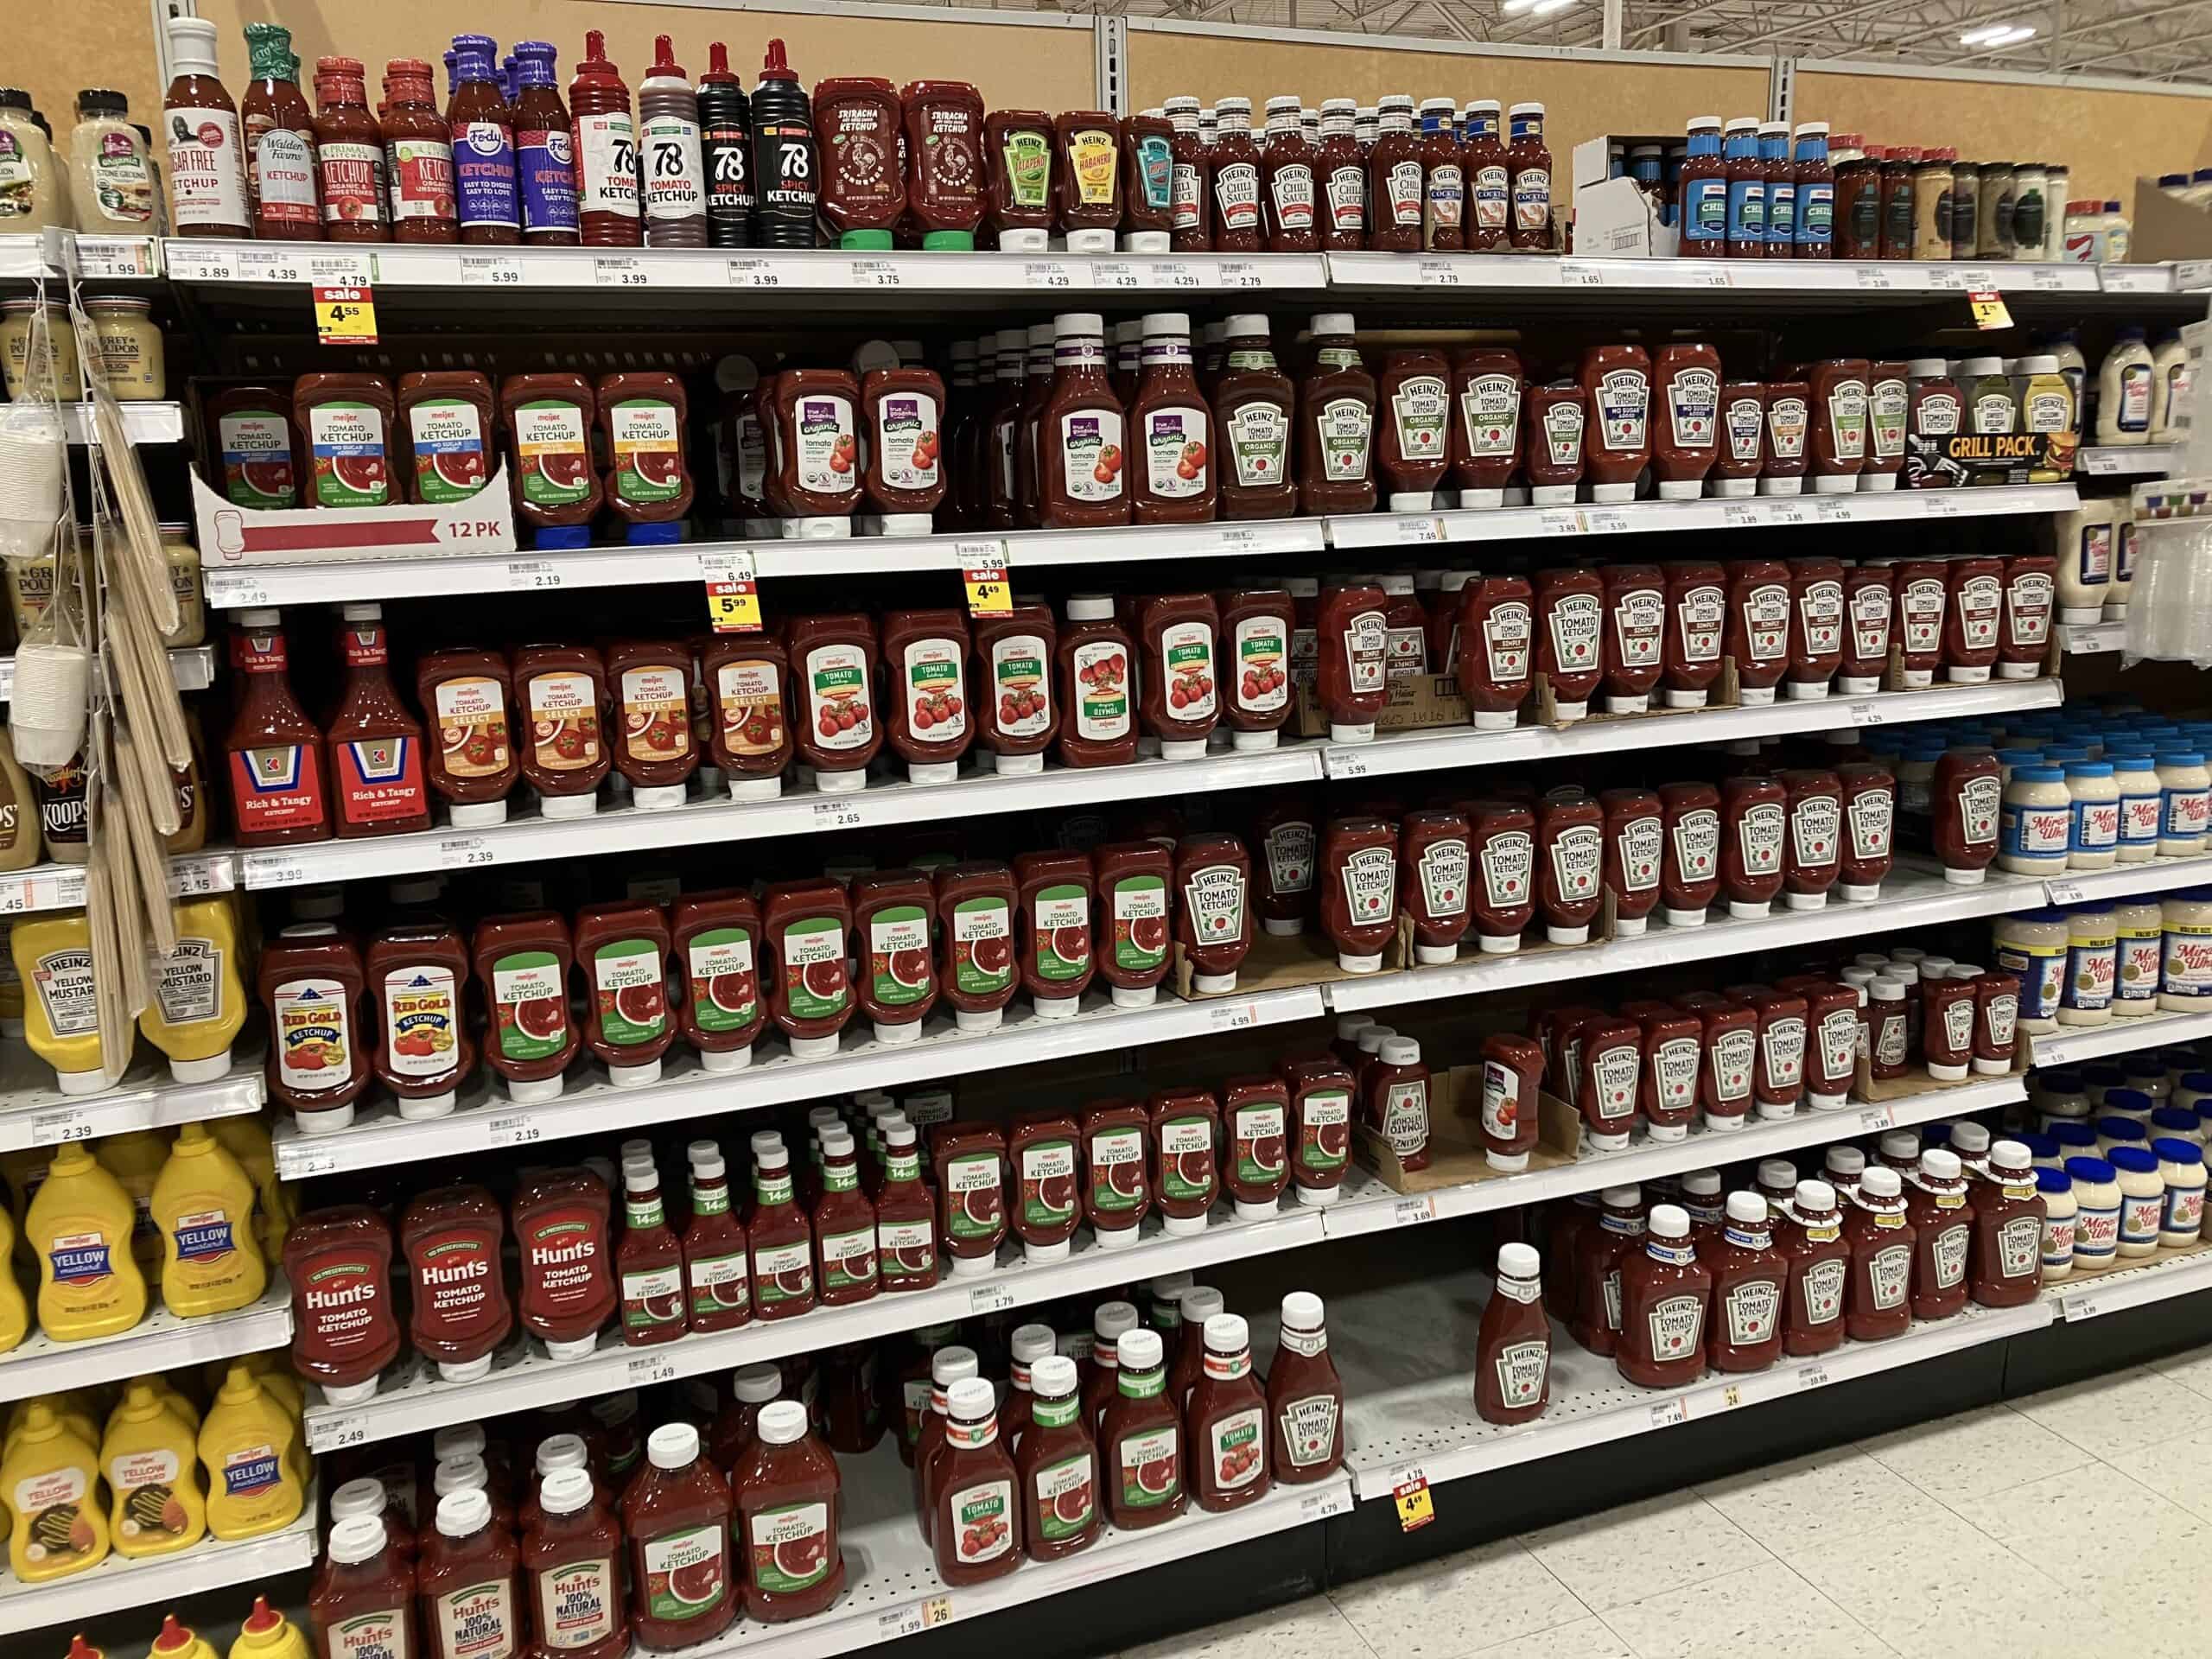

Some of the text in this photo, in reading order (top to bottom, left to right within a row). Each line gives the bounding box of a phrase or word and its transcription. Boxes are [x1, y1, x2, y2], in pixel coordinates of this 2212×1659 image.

[838, 110, 877, 119] SRIRACHA
[840, 123, 877, 131] KETCHUP
[469, 130, 501, 147] Fody
[1016, 138, 1041, 147] HEINZ
[1082, 136, 1106, 145] HEINZ
[266, 138, 302, 151] Walden
[190, 151, 216, 170] FREE
[270, 150, 302, 161] Farms
[653, 143, 683, 176] 78
[779, 143, 808, 178] 78
[713, 147, 745, 180] 78
[1079, 155, 1111, 170] HABANERO
[266, 170, 308, 181] KETCHUP
[325, 161, 368, 183] KETCHUP
[460, 163, 513, 178] KETCHUP
[1226, 169, 1249, 181] HEINZ
[1524, 173, 1546, 185] HEINZ
[651, 181, 691, 189] TOMATO
[715, 183, 745, 192] SPICY
[1228, 182, 1251, 194] CHILI
[646, 191, 697, 203] KETCHUP
[1228, 191, 1255, 203] SAUCE
[105, 264, 135, 275] 1.99
[200, 268, 229, 278] 3.89
[268, 270, 297, 280] 4.39
[339, 276, 366, 286] 4.79
[492, 272, 518, 283] 5.99
[622, 275, 646, 284] 3.99
[753, 276, 778, 284] 3.99
[878, 275, 899, 283] 3.75
[1048, 276, 1069, 285] 4.29
[1116, 276, 1137, 285] 4.29
[1174, 276, 1194, 285] 4.29
[1240, 276, 1261, 286] 2.79
[324, 289, 359, 301] sale
[1685, 376, 1711, 389] HEINZ
[1409, 385, 1438, 397] HEINZ
[1478, 383, 1509, 394] HEINZ
[333, 414, 358, 423] meijer
[327, 423, 365, 433] TOMATO
[533, 423, 567, 432] TOMATO
[805, 422, 838, 434] organic
[887, 420, 919, 431] organic
[321, 433, 373, 442] KETCHUP
[526, 431, 575, 441] KETCHUP
[1949, 437, 1991, 457] GRILL
[448, 521, 501, 538] 12 PK
[983, 559, 1003, 569] 5.99
[536, 575, 560, 586] 2.19
[728, 571, 752, 581] 6.49
[972, 570, 999, 581] sale
[716, 583, 747, 594] sale
[1759, 594, 1783, 603] HEINZ
[1566, 601, 1591, 612] HEINZ
[1560, 618, 1595, 628] TOMATO
[1250, 639, 1274, 650] TOMATO
[823, 672, 851, 683] TOMATO
[542, 697, 583, 708] KETCHUP
[734, 695, 768, 706] SELECT
[449, 704, 491, 714] KETCHUP
[452, 714, 490, 724] SELECT
[1348, 766, 1366, 775] 5.99
[353, 787, 415, 802] Rich & Tangy
[246, 795, 311, 810] Rich & Tangy
[1808, 803, 1831, 813] HEINZ
[837, 813, 860, 824] 2.65
[1689, 817, 1713, 828] HEINZ
[467, 852, 493, 862] 2.39
[1359, 855, 1385, 866] HEINZ
[1203, 873, 1232, 886] HEINZ
[1354, 870, 1389, 882] TOMATO
[1357, 879, 1389, 890] KETCHUP
[1198, 889, 1237, 901] TOMATO
[1201, 899, 1236, 910] KETCHUP
[799, 944, 830, 954] TOMATO
[793, 950, 836, 962] KETCHUP
[165, 964, 202, 976] YELLOW
[511, 982, 545, 992] TOMATO
[503, 987, 553, 1001] KETCHUP
[393, 999, 450, 1012] RED GOLD
[283, 1011, 341, 1026] RED GOLD
[401, 1015, 442, 1026] KETCHUP
[293, 1029, 333, 1039] KETCHUP
[1607, 1052, 1630, 1065] HEINZ
[63, 1126, 92, 1140] 2.39
[516, 1129, 539, 1141] 2.19
[1244, 1127, 1281, 1137] KETCHUP
[892, 1167, 913, 1178] 14oz
[956, 1179, 997, 1189] KETCHUP
[635, 1214, 659, 1224] 14oz
[2012, 1224, 2031, 1233] HEINZ
[179, 1228, 228, 1243] YELLOW
[185, 1239, 224, 1251] mustard
[54, 1251, 104, 1266] YELLOW
[60, 1264, 100, 1274] mustard
[1741, 1287, 1769, 1299] HEINZ
[995, 1297, 1014, 1306] 1.79
[320, 1308, 367, 1322] TOMATO
[317, 1317, 372, 1332] KETCHUP
[1514, 1350, 1540, 1361] HEINZ
[652, 1367, 674, 1379] 1.49
[1728, 1395, 1738, 1405] 24
[1299, 1405, 1326, 1417] HEINZ
[1667, 1414, 1682, 1422] 7.49
[339, 1430, 364, 1445] 2.49
[226, 1463, 274, 1481] YELLOW
[1400, 1480, 1421, 1493] sale
[967, 1500, 999, 1513] TOMATO
[1320, 1505, 1338, 1515] 4.79
[660, 1552, 709, 1570] KETCHUP
[565, 1592, 591, 1604] 100%
[556, 1599, 601, 1613] NATURAL
[934, 1609, 947, 1622] 26
[899, 1621, 920, 1634] 1.99
